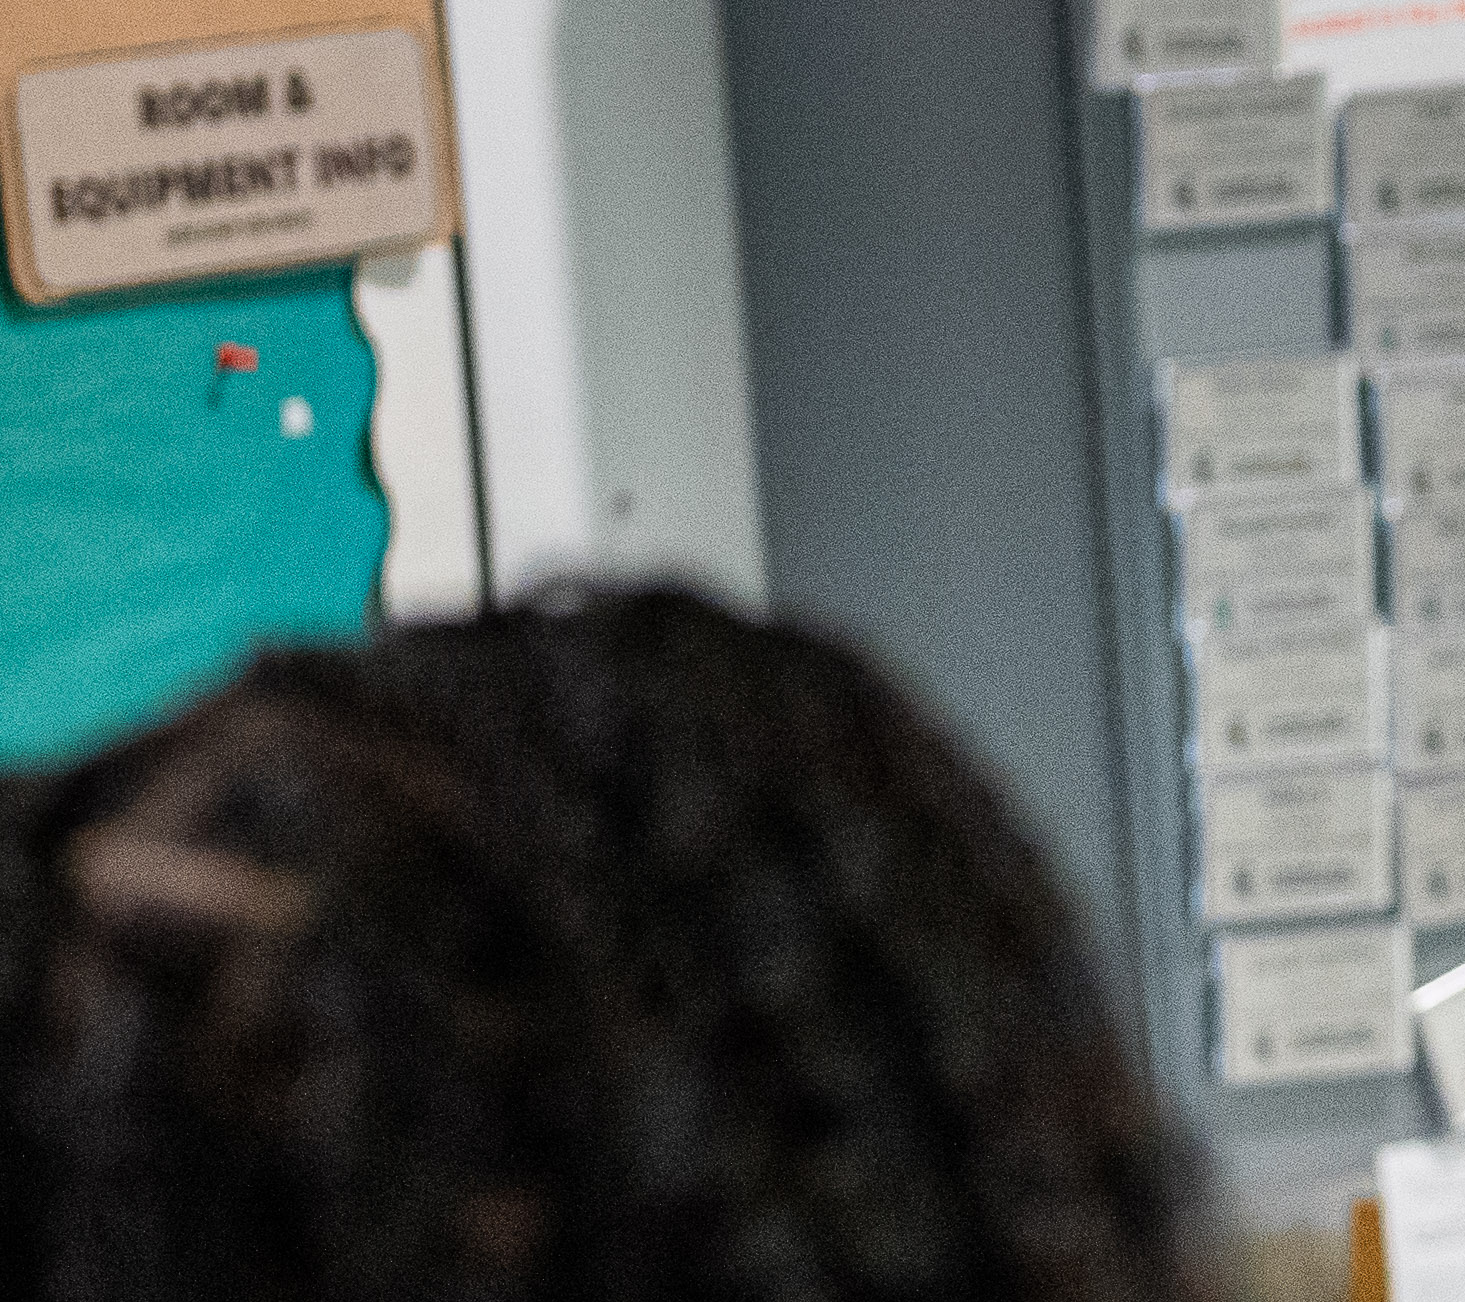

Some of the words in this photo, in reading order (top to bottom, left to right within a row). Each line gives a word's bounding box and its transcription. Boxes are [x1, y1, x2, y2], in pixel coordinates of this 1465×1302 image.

[135, 73, 270, 132] ROOM
[285, 67, 315, 112] &
[50, 147, 301, 227] EQUIPMENT
[317, 131, 417, 188] INFO
